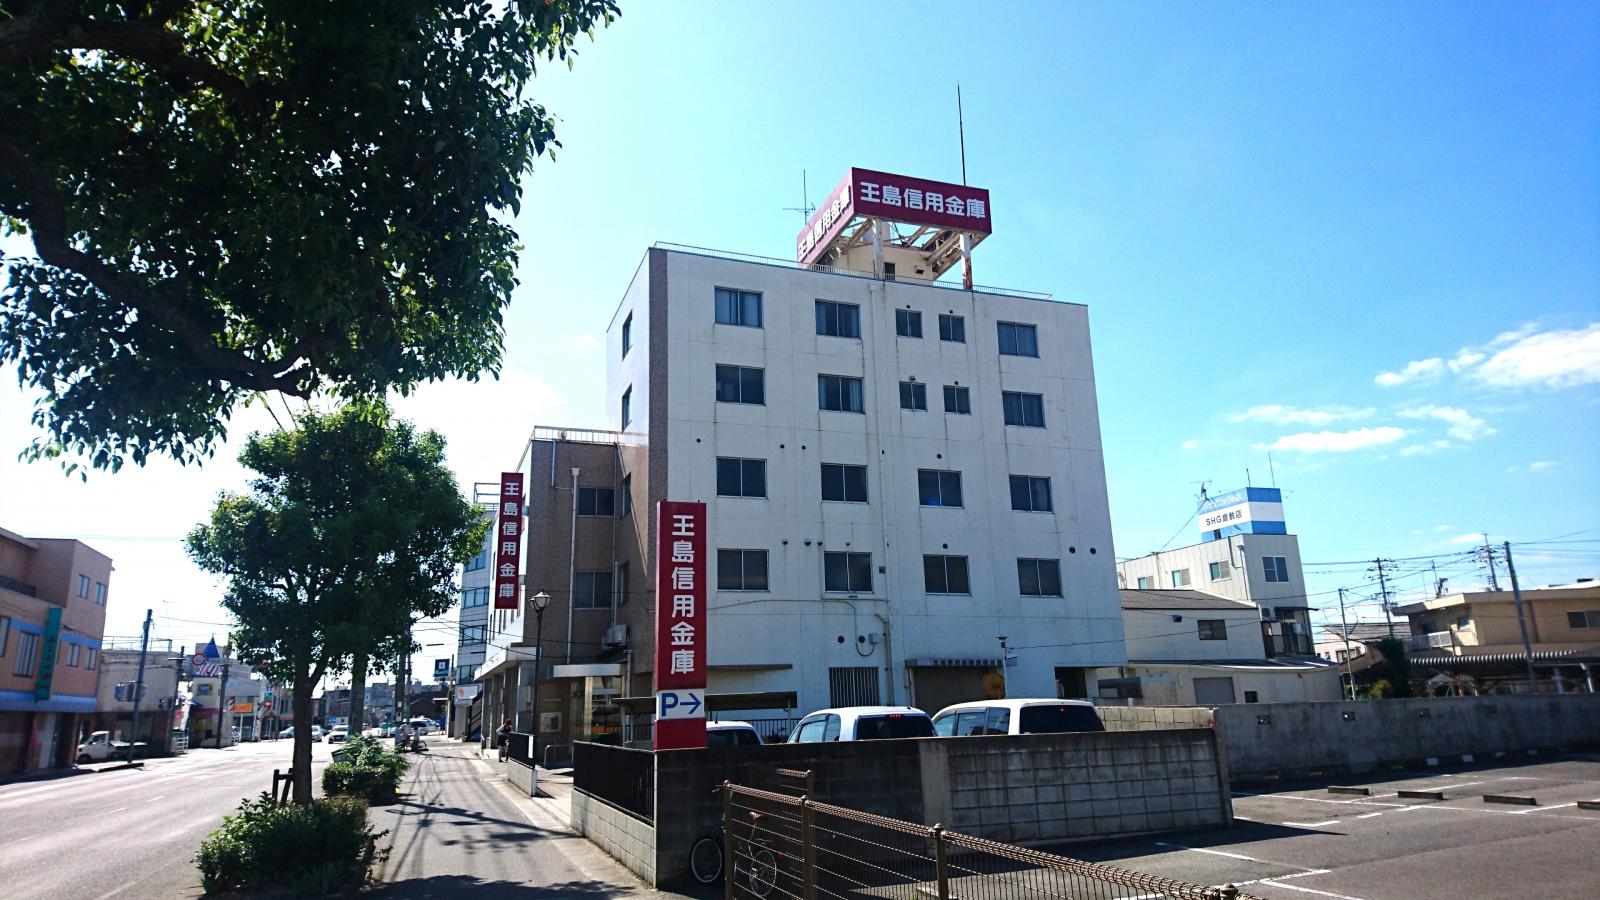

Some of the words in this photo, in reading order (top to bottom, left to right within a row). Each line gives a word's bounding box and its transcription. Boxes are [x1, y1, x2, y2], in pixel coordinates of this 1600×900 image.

[860, 182, 986, 219] 玉島信用金庫
[1206, 510, 1242, 526] SHG倉敷店
[498, 482, 519, 598] 玉島信用金庫
[671, 514, 695, 675] 玉島信用金庫
[661, 692, 679, 717] P
